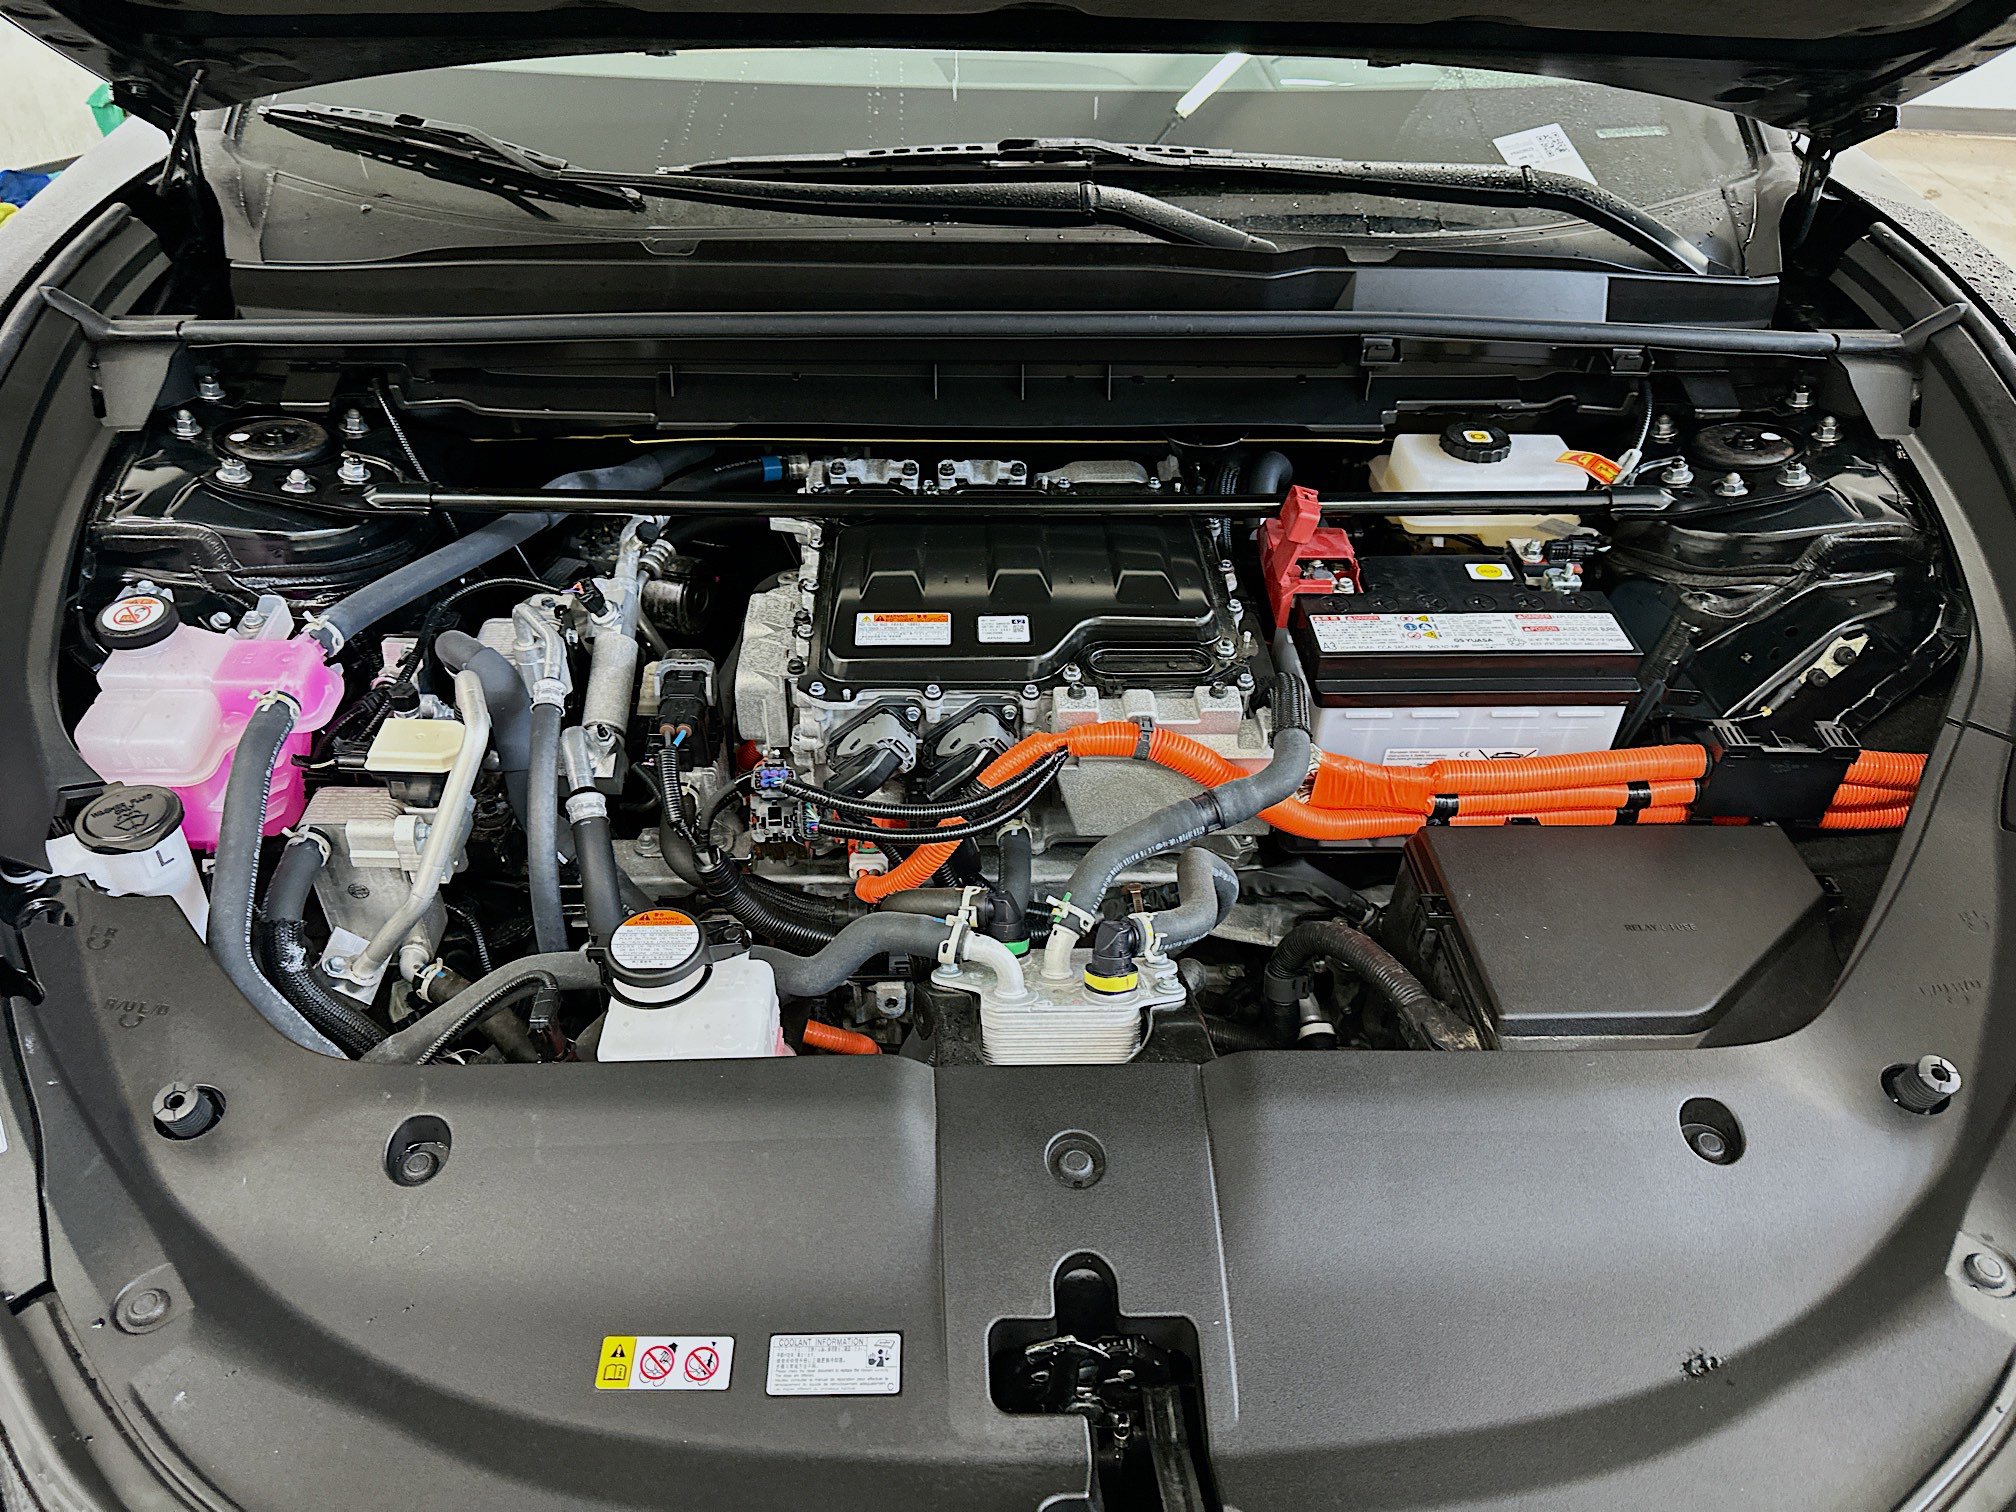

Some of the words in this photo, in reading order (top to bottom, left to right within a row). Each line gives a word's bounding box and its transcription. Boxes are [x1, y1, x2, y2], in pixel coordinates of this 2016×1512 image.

[1323, 642, 1337, 650] A3
[156, 850, 174, 866] L
[778, 1338, 812, 1346] COOLANT
[815, 1338, 864, 1346] INFORMATION
[887, 1382, 894, 1390] C
